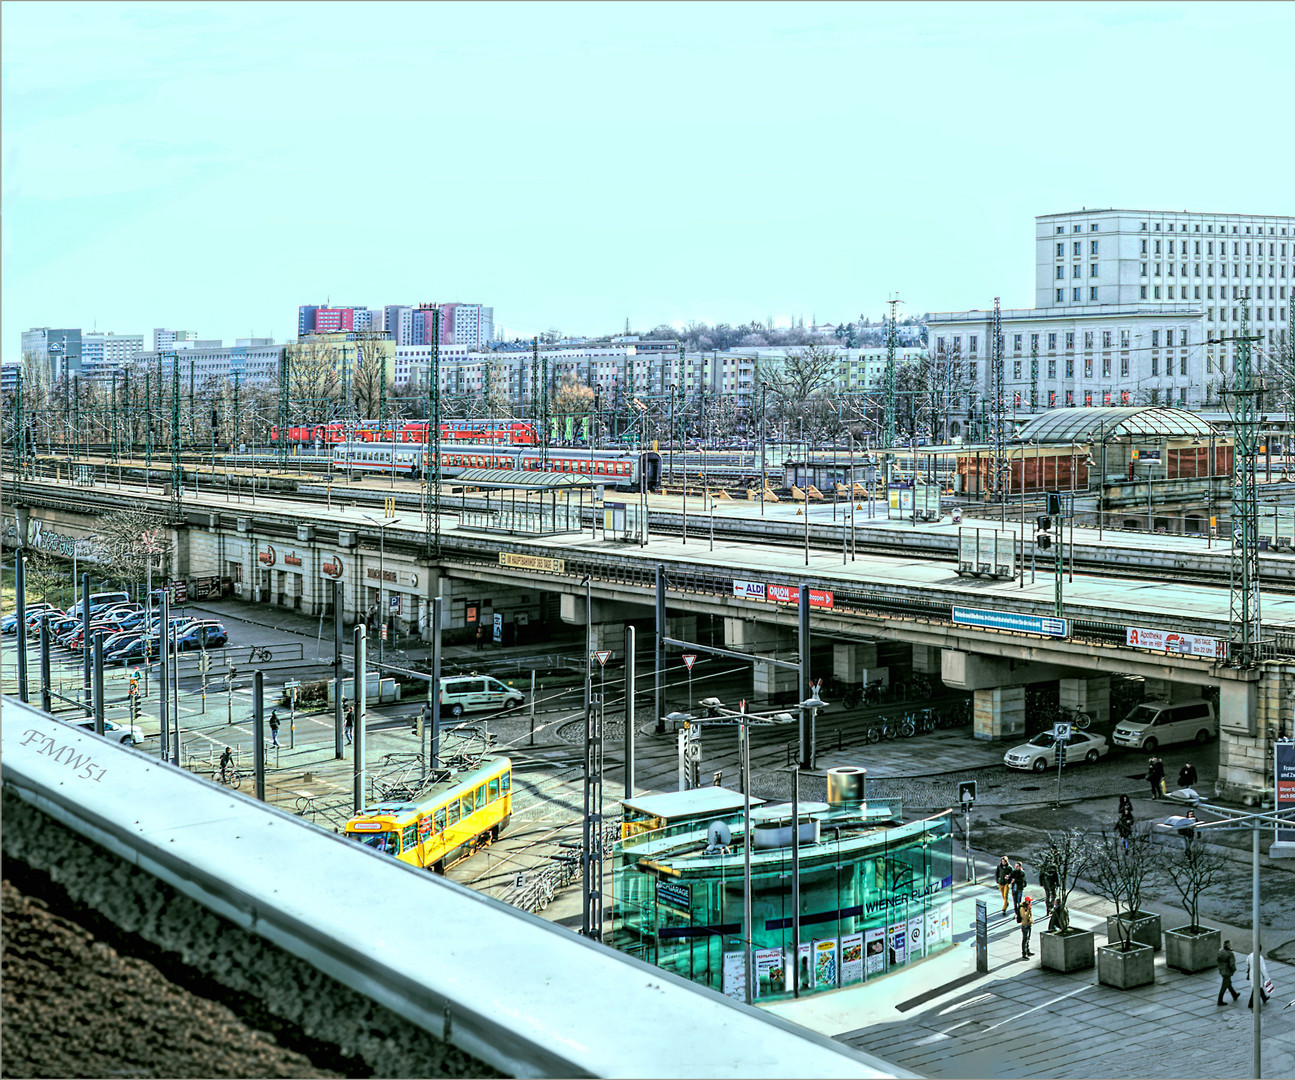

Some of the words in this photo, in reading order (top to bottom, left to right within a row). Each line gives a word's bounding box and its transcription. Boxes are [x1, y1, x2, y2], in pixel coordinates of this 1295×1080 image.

[746, 583, 764, 594] ALDI
[769, 586, 790, 600] ORION
[391, 597, 397, 606] P
[808, 593, 825, 603] hoppen
[1140, 631, 1163, 640] Apotheke
[866, 893, 909, 914] WIENER
[911, 881, 940, 900] PLATZ
